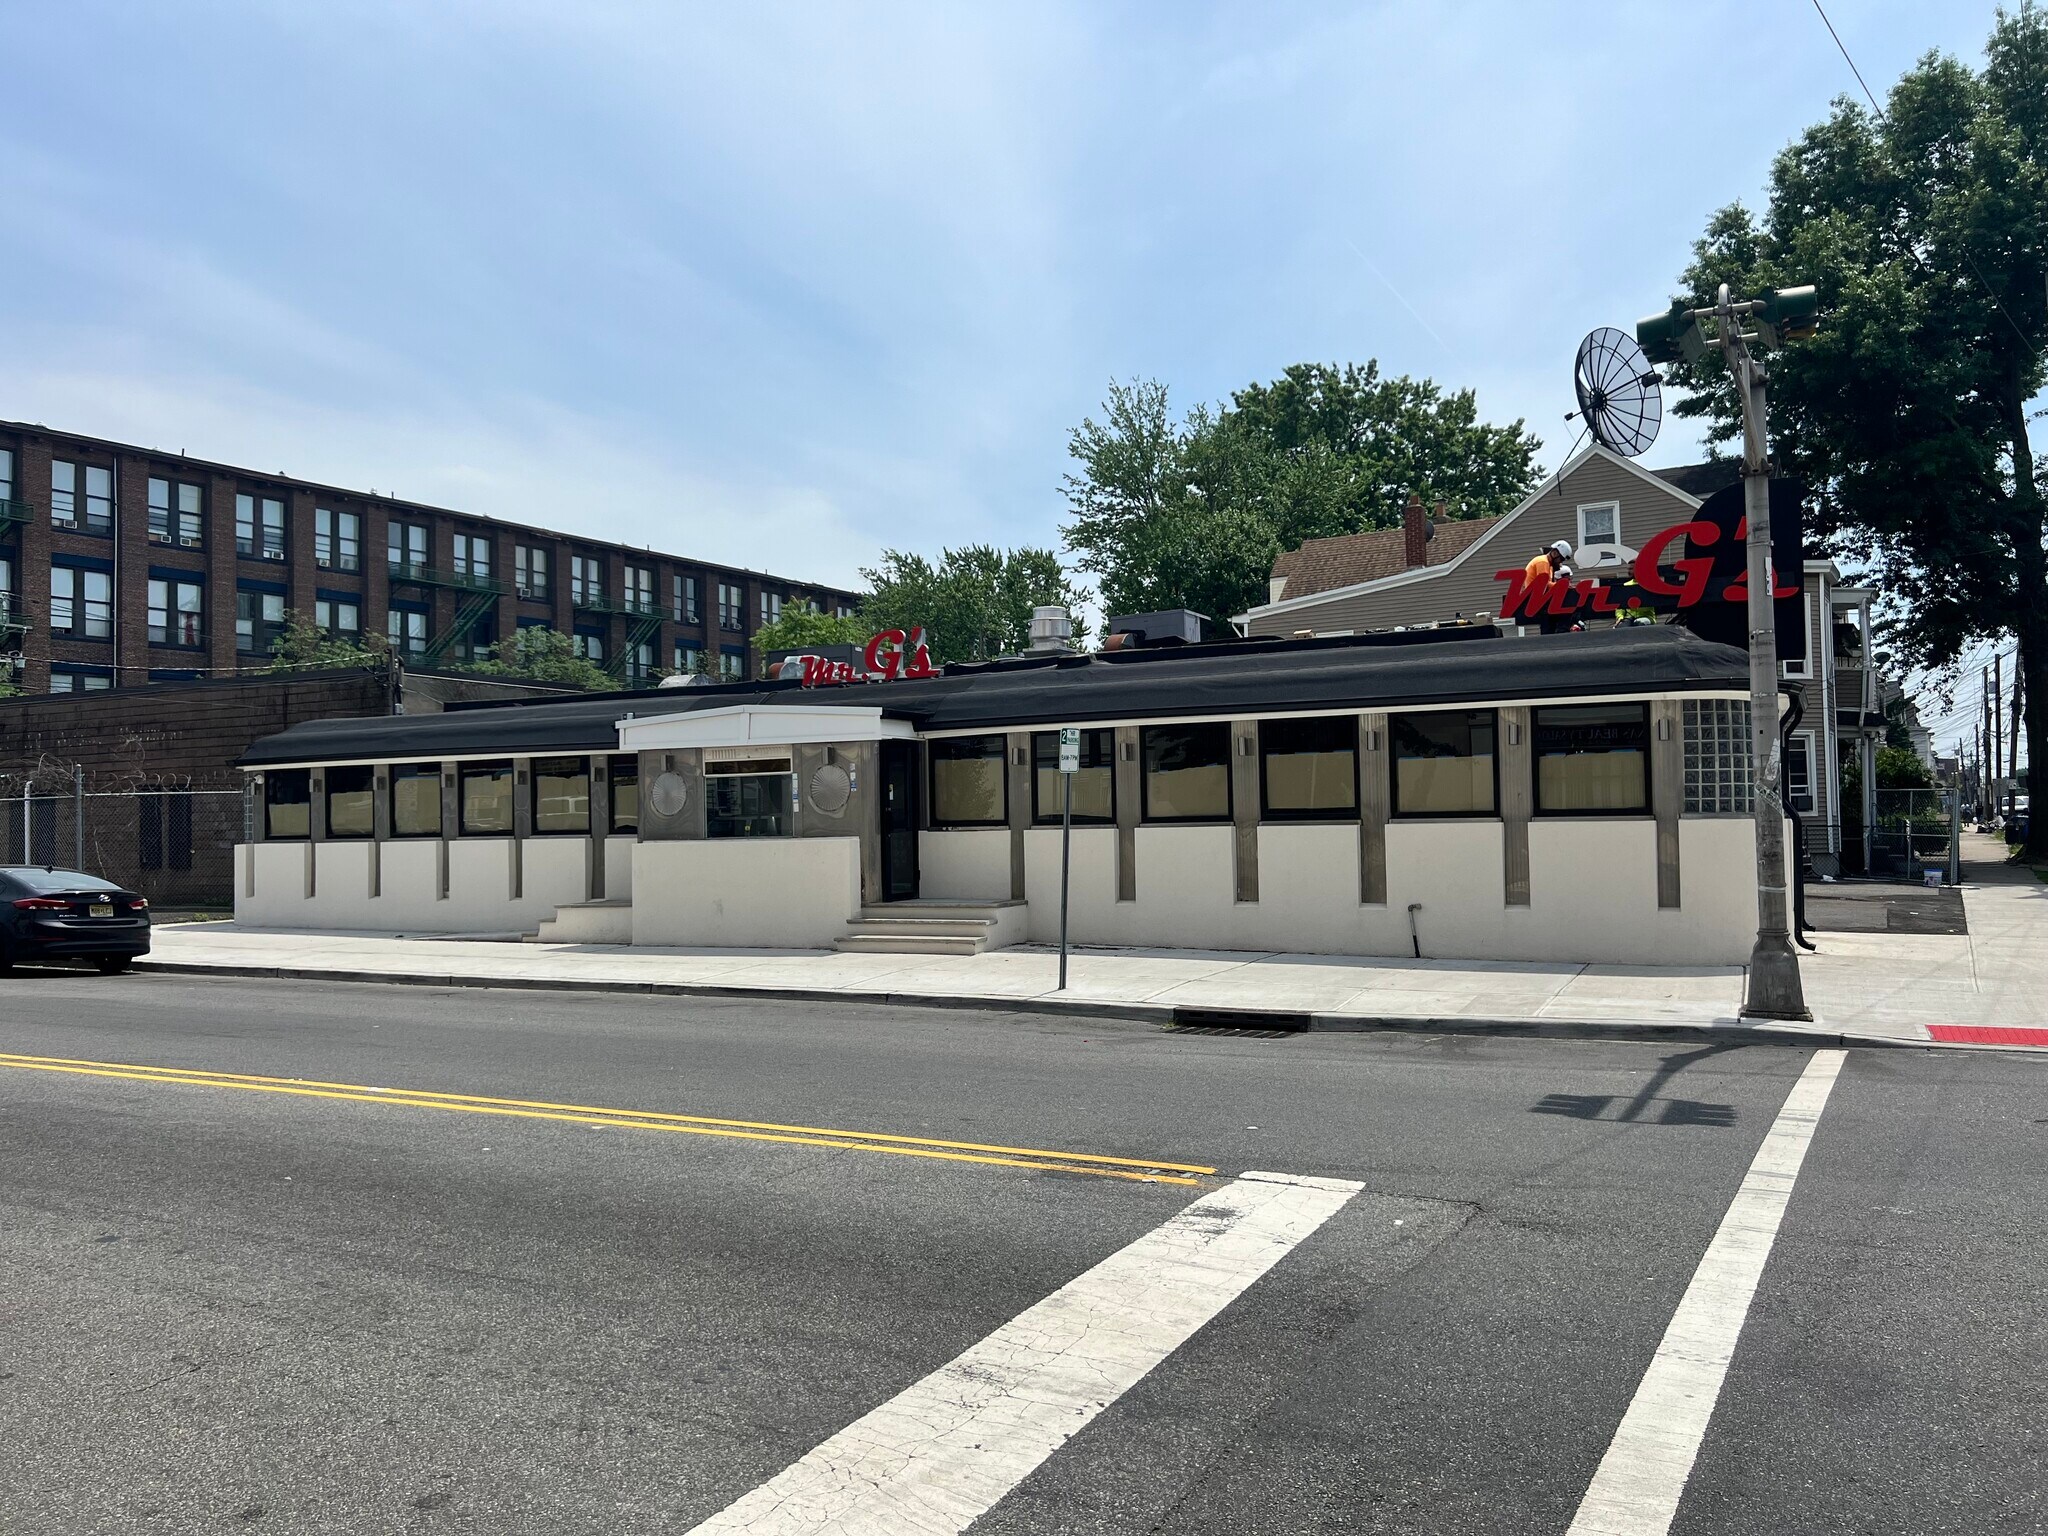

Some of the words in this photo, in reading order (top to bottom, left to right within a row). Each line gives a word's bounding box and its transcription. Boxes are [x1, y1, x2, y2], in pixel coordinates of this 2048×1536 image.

[1493, 568, 1642, 618] Mr.
[799, 655, 870, 687] Mr.
[864, 625, 942, 681] G's
[1061, 730, 1067, 742] 2
